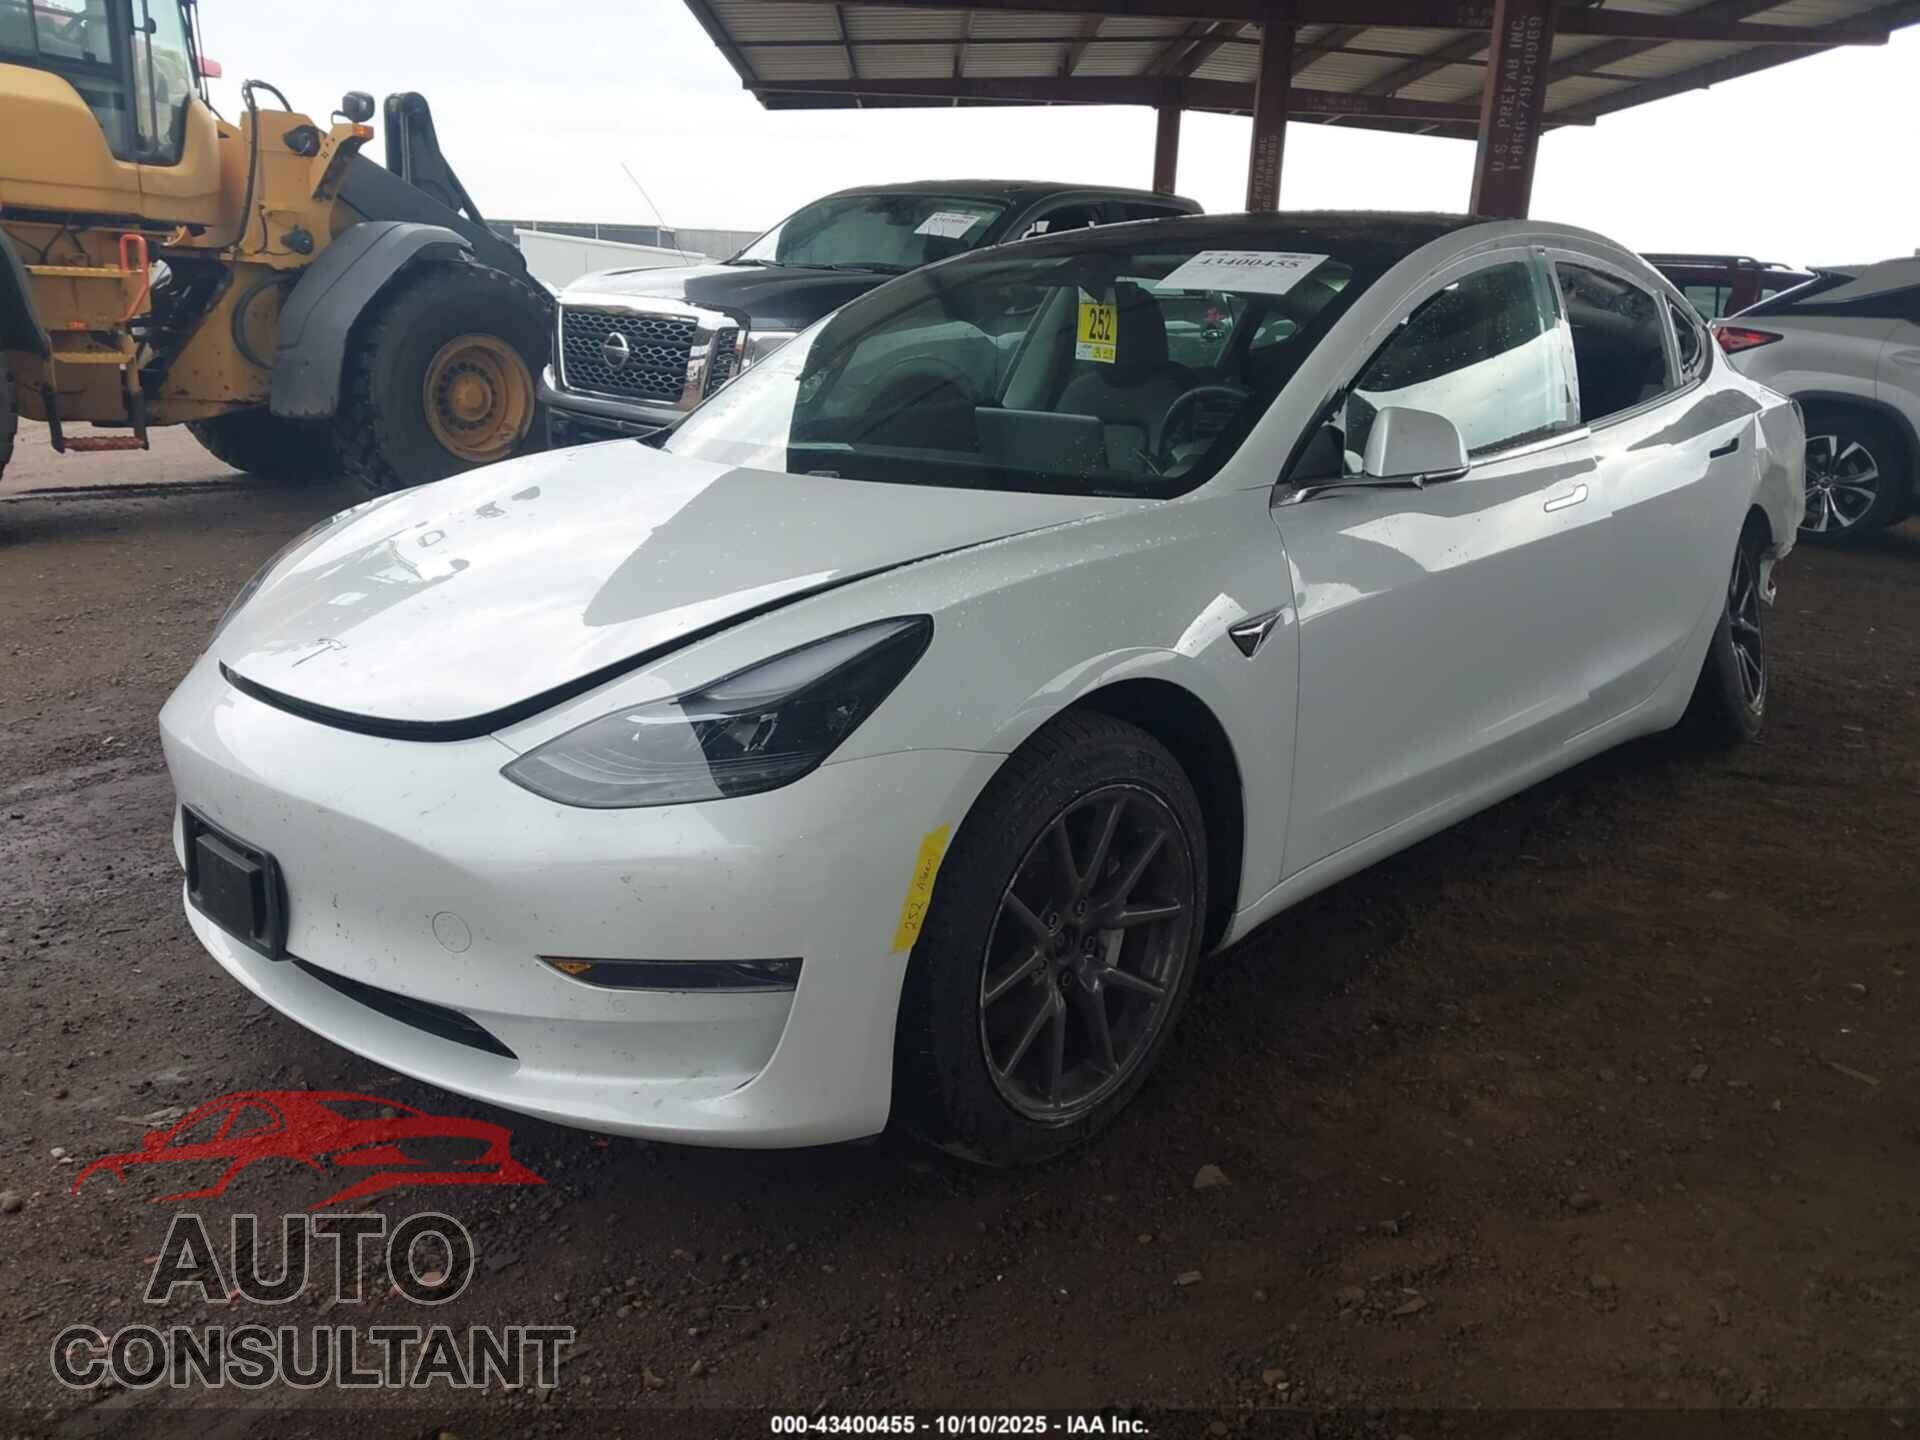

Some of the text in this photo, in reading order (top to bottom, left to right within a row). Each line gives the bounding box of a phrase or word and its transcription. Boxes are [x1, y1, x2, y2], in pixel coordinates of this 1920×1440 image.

[1498, 58, 1520, 128] PREFAB
[1088, 307, 1112, 341] 252
[904, 902, 926, 930] 252
